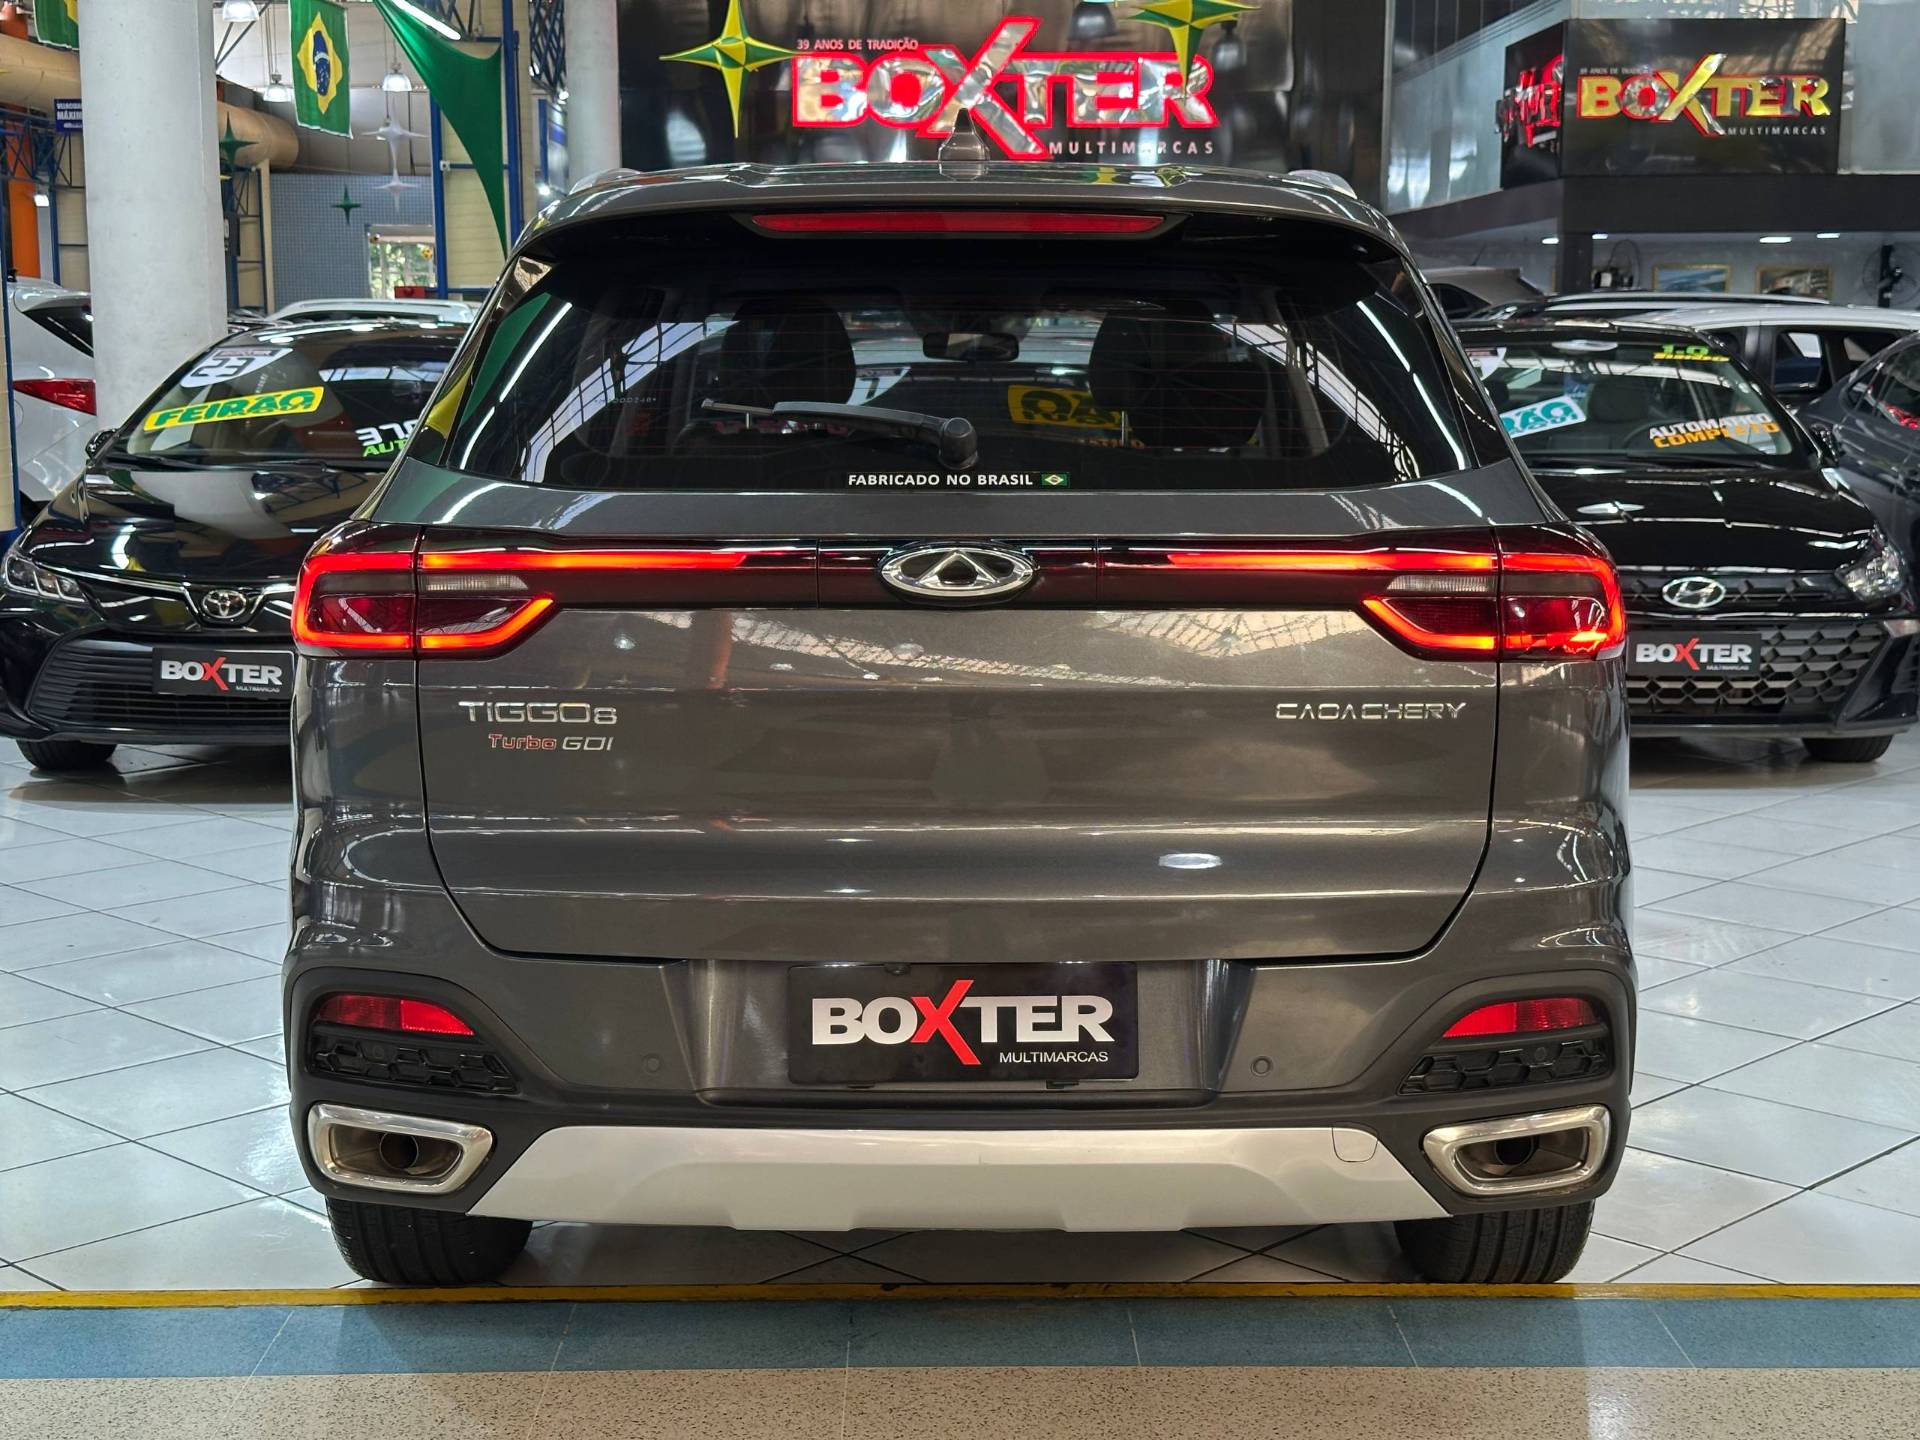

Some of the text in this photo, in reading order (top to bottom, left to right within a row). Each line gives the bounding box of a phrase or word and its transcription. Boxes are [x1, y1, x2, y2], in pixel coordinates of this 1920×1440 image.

[796, 37, 919, 50] 39 ANOS DE TRADIÇÃO
[792, 17, 1220, 160] BOXTER
[1577, 53, 1831, 137] BOXTER
[1727, 126, 1826, 136] MULTIMARCAS
[190, 357, 256, 377] 23
[848, 474, 1033, 486] FABRICADO NO BRASIL
[1636, 638, 1752, 670] BOXTER
[161, 656, 283, 690] BOXTER
[488, 733, 615, 751] Turbo GDI
[812, 979, 1115, 1065] BOXTER
[999, 1051, 1109, 1063] MULTIMARCAS
